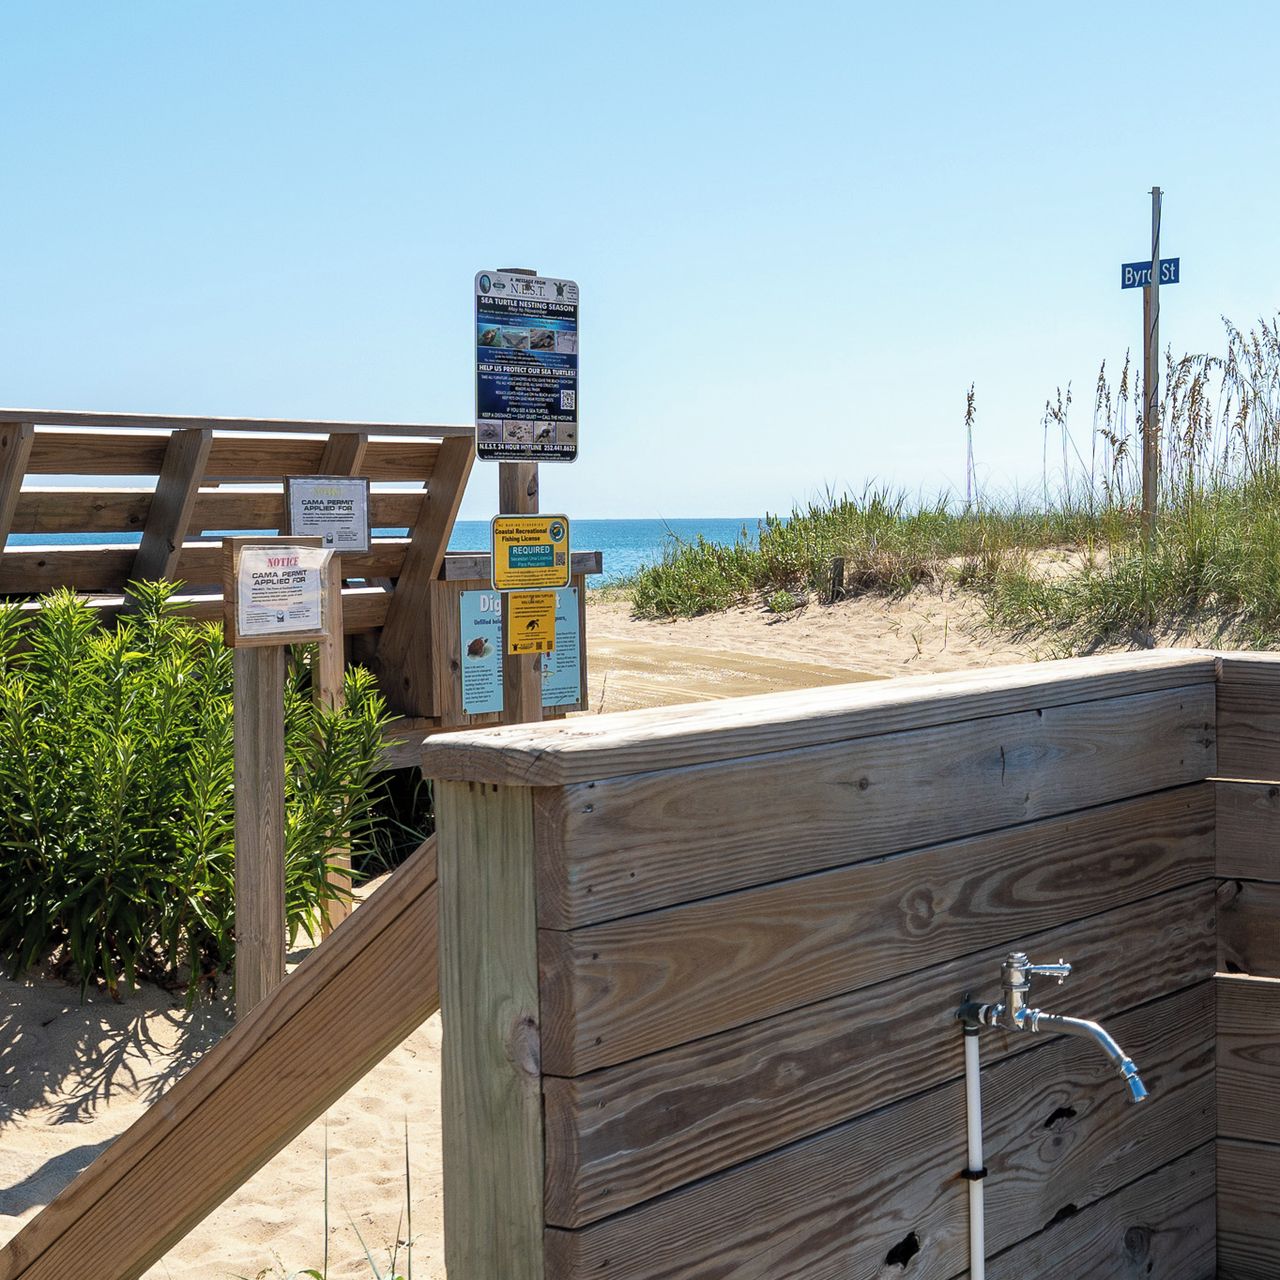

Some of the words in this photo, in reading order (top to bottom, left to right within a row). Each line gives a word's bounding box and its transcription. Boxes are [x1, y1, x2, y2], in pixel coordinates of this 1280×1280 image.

[1162, 263, 1175, 280] St
[495, 298, 518, 307] TURTLE
[519, 301, 547, 309] NESTING
[549, 303, 574, 312] SEASON
[503, 366, 527, 374] PROTECT
[513, 546, 550, 554] REQUIRED
[268, 557, 299, 567] NOTICE
[254, 578, 289, 586] APPLIED
[480, 595, 502, 617] Dig
